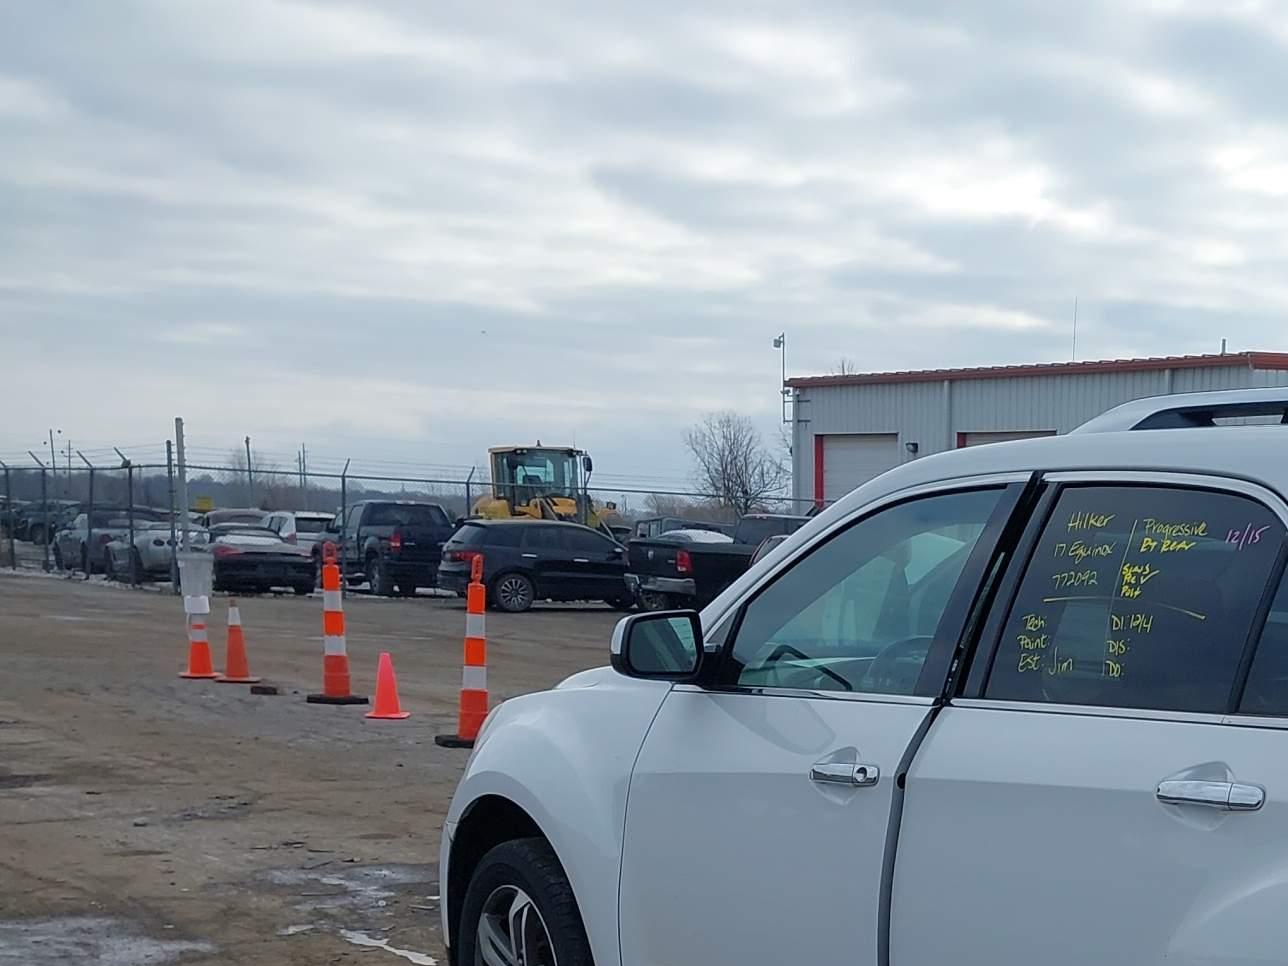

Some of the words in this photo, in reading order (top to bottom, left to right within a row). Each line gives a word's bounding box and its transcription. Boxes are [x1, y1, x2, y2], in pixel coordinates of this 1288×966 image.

[1067, 511, 1116, 533] Hilker
[1143, 518, 1209, 537] Progressive
[1225, 522, 1271, 550] 12/15
[1068, 540, 1117, 564] Equinox
[1052, 569, 1099, 590] 772092
[1048, 646, 1073, 676] Jim
